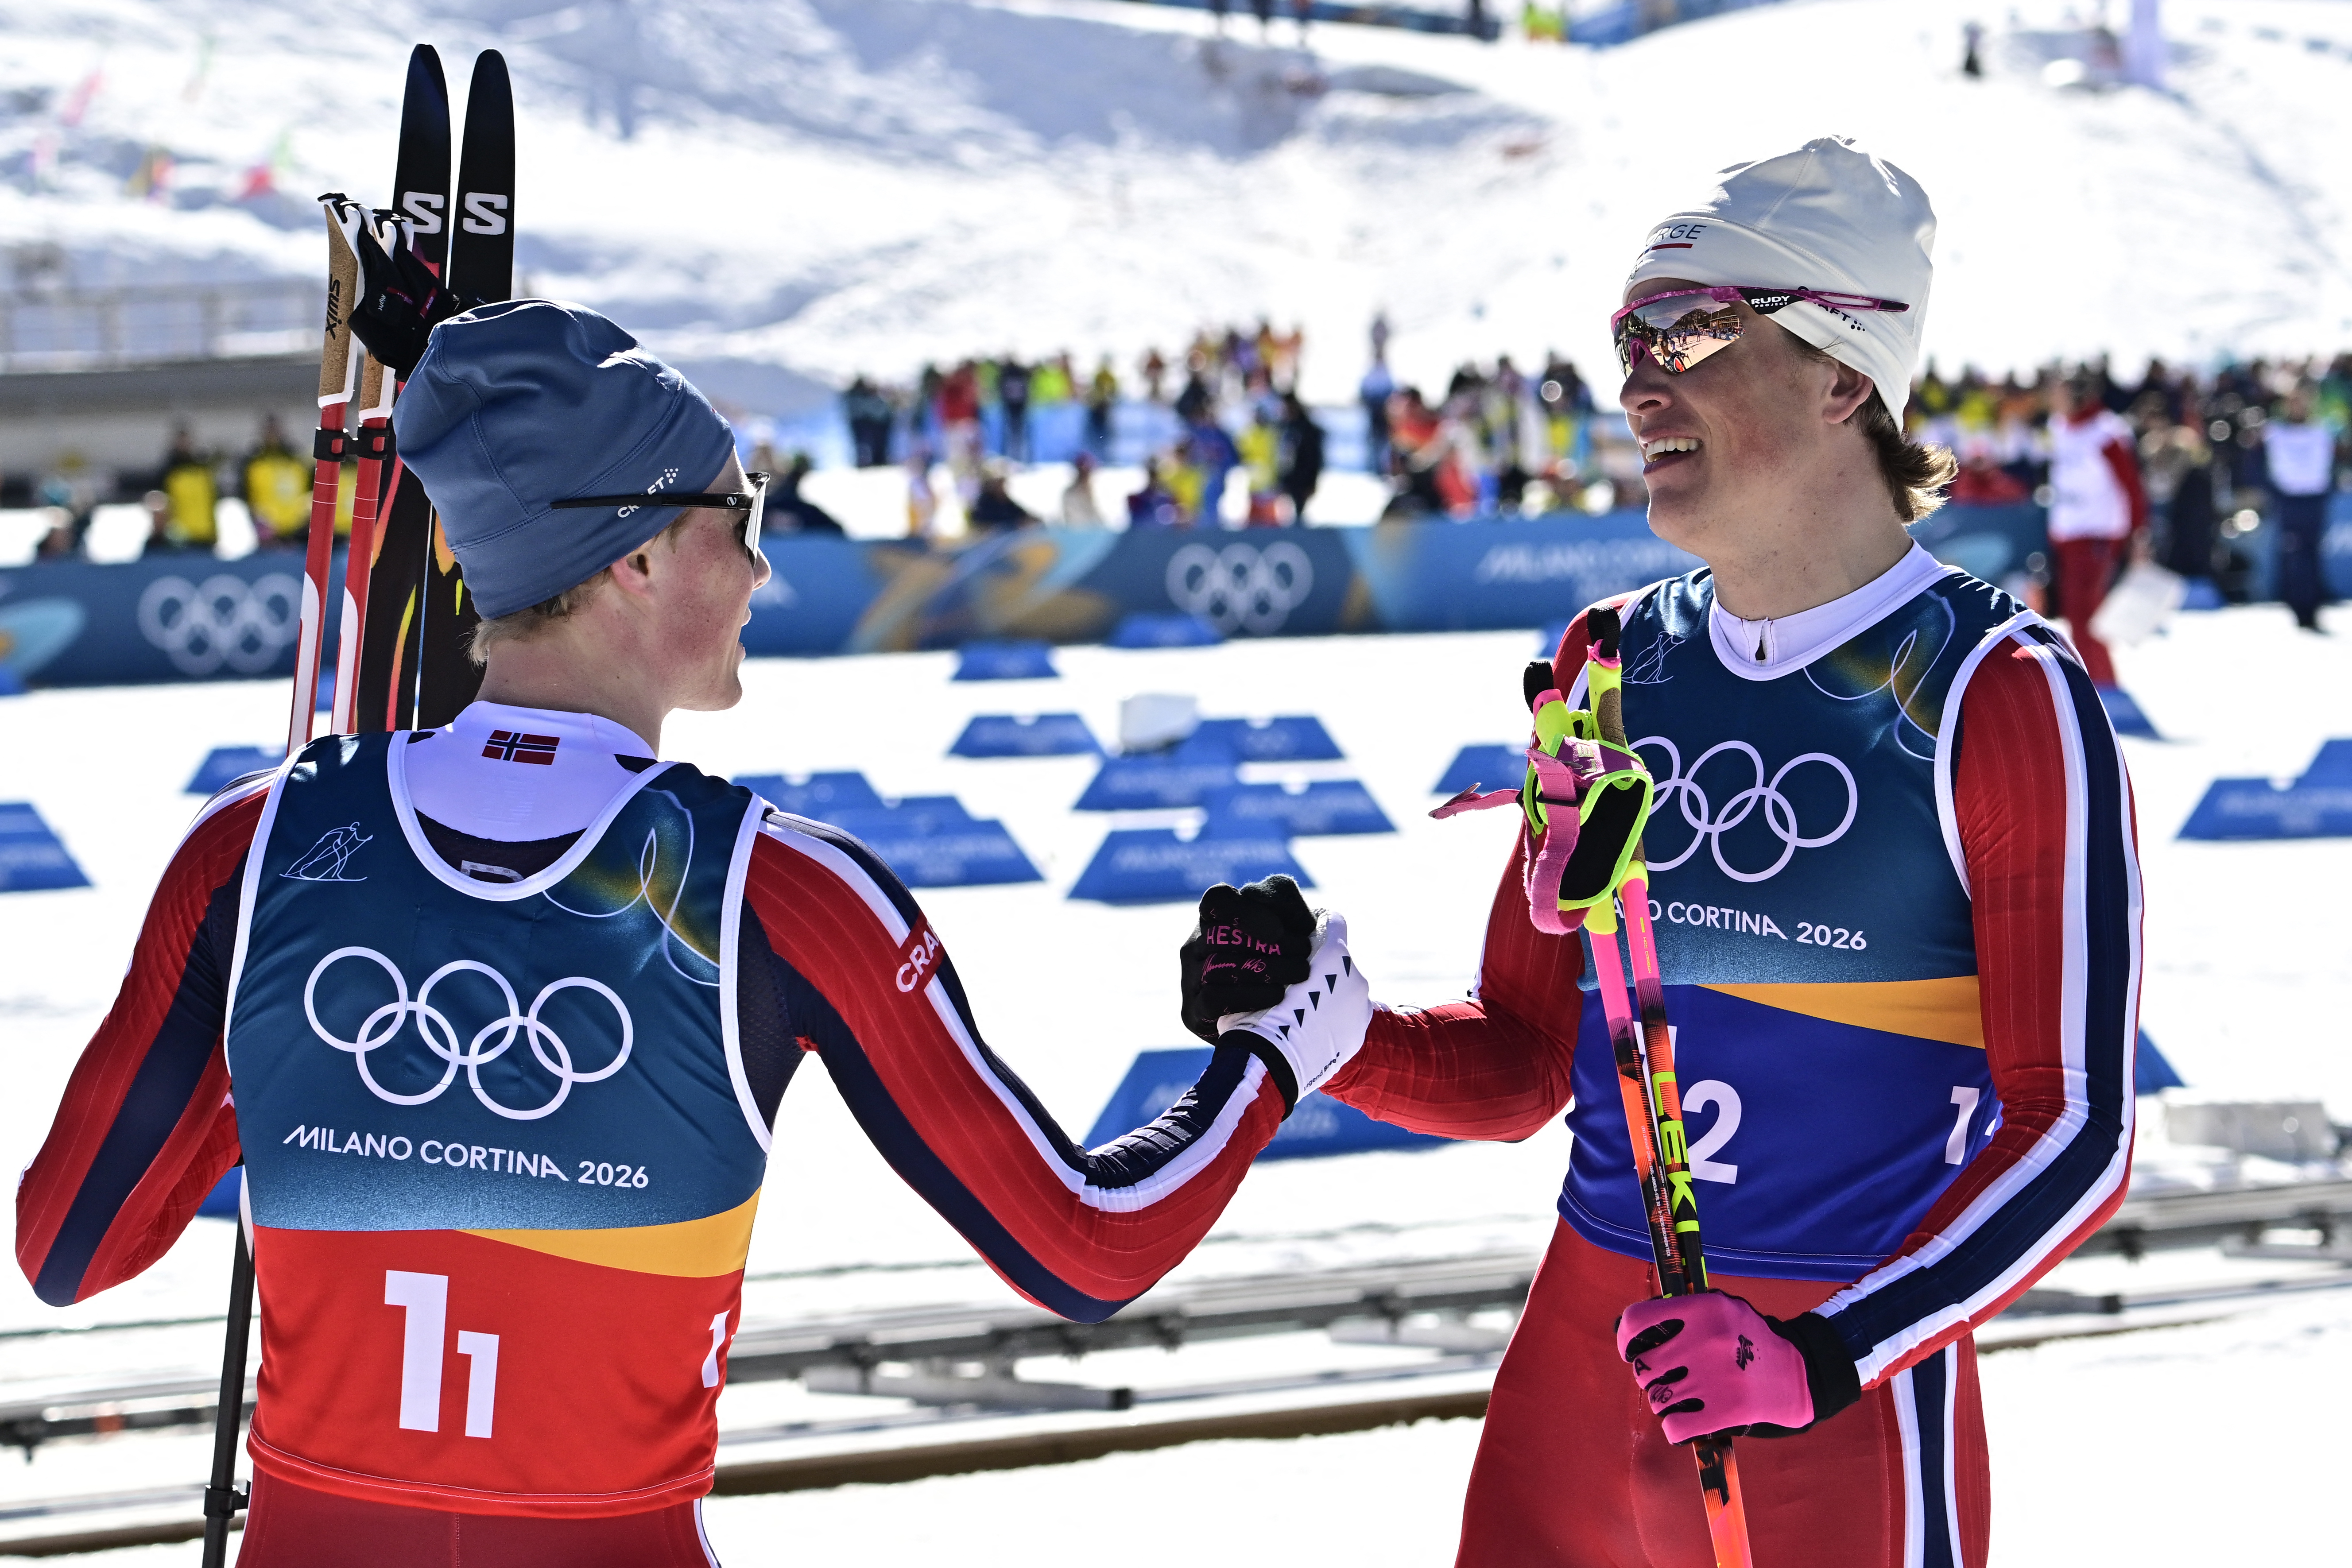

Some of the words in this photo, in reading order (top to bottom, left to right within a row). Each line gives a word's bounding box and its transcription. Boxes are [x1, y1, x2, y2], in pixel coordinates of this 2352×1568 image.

[463, 192, 508, 235] S
[1646, 224, 1707, 247] RGE
[378, 294, 386, 311] Right
[1751, 295, 1790, 305] RUDY
[1207, 925, 1281, 955] HESTRA
[1667, 902, 1788, 940] CORTINA
[1796, 922, 1867, 950] 2026
[896, 920, 939, 992] CRA
[283, 1124, 413, 1160] MILANO
[420, 1140, 570, 1181] CORTINA
[577, 1161, 649, 1188] 2026
[1652, 1071, 1700, 1233] LEKI
